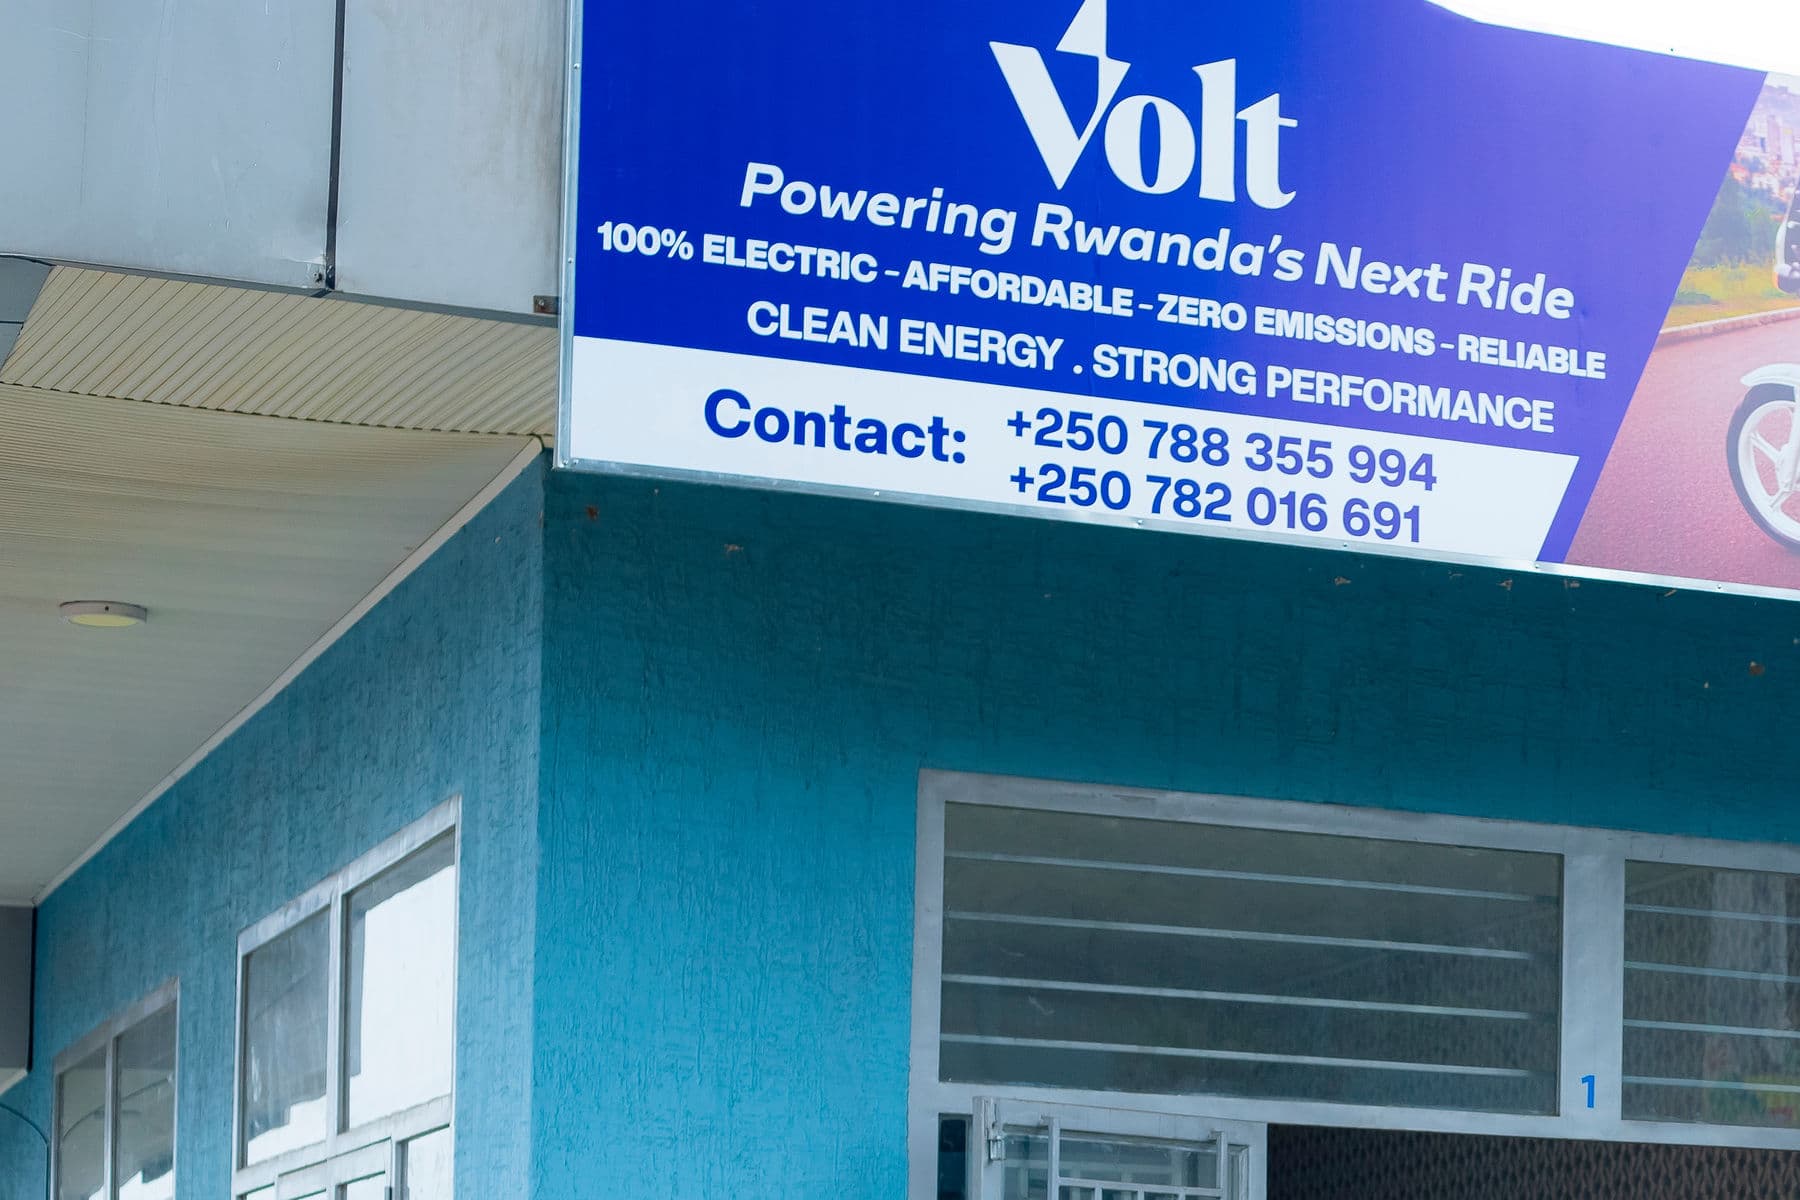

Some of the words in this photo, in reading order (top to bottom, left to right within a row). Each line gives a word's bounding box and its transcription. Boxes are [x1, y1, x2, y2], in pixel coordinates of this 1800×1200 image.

[989, 0, 1298, 209] Volt
[597, 221, 694, 261] 100%
[703, 233, 878, 283] ELECTRIC
[1254, 306, 1436, 356] EMISSIONS
[740, 162, 1017, 255] Powering
[1314, 242, 1449, 302] Next
[1456, 262, 1575, 319] Ride
[747, 300, 889, 350] CLEAN
[900, 318, 1065, 371] ENERGY
[1092, 343, 1257, 396] STRONG
[1266, 364, 1555, 434] PERFORMANCE
[704, 388, 967, 464] Contact:
[1007, 407, 1129, 455] +250
[1143, 419, 1230, 467] 788
[1244, 432, 1334, 480] 355
[1349, 445, 1437, 492] 994
[1010, 463, 1132, 510] +250
[1146, 475, 1232, 522] 782
[1247, 487, 1328, 532] 016
[1342, 498, 1421, 543] 691
[1581, 1075, 1595, 1108] 1
